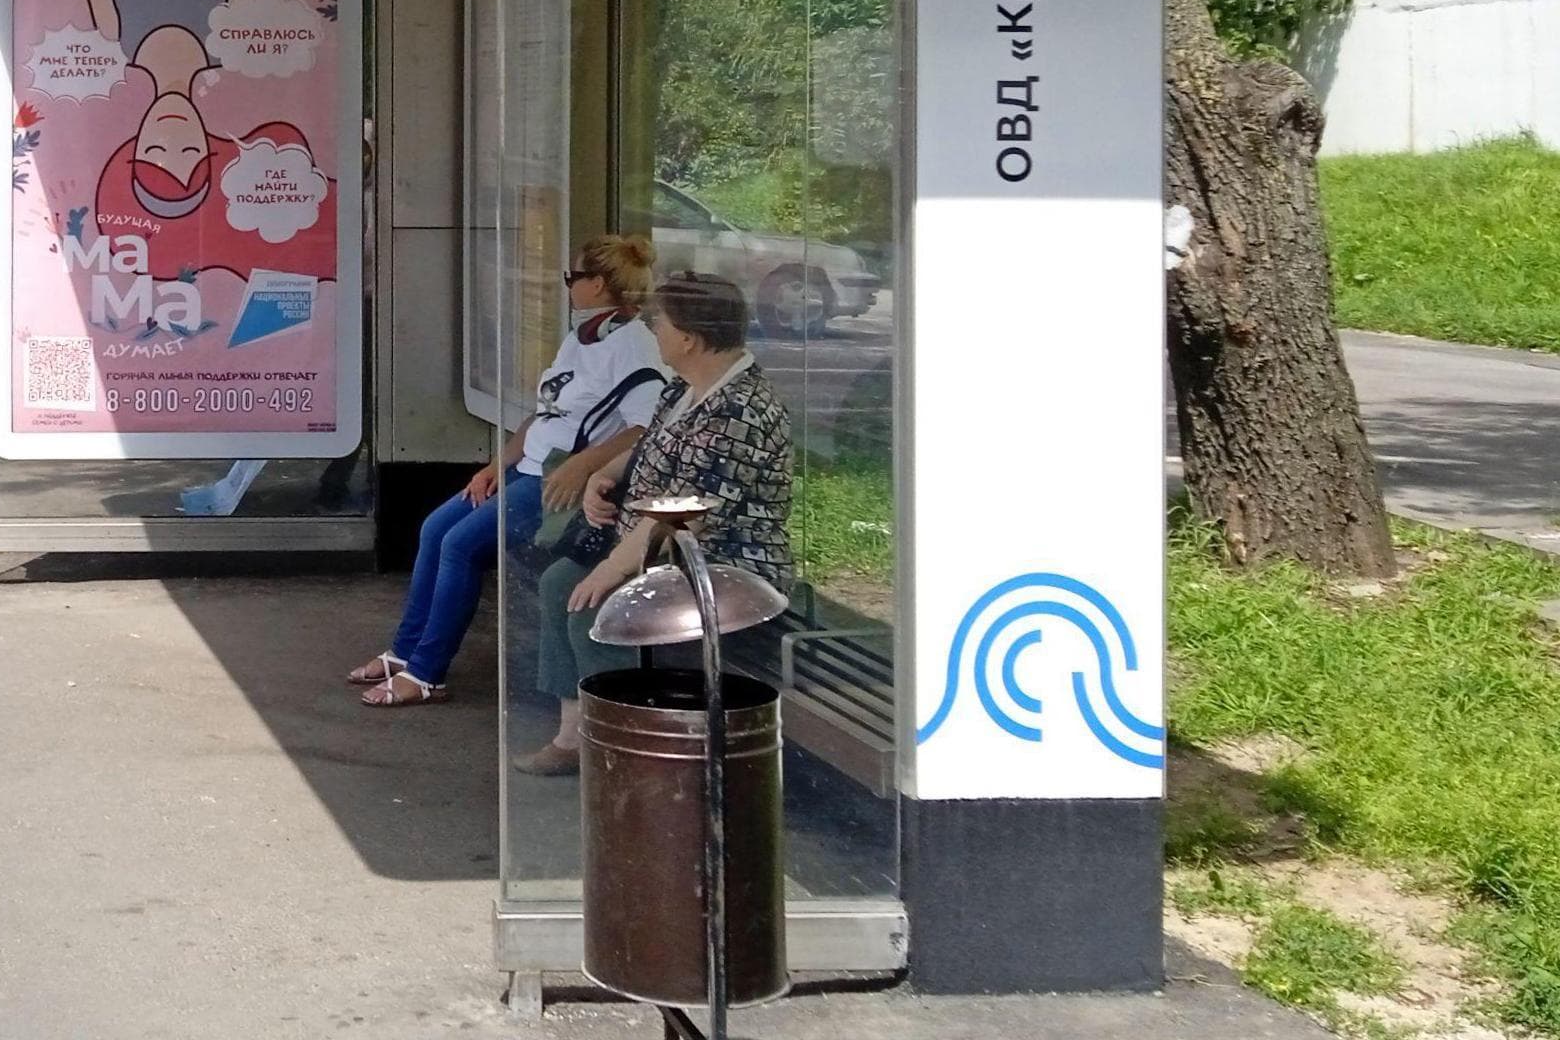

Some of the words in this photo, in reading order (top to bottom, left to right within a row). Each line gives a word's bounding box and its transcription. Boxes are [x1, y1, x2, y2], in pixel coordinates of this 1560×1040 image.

[220, 28, 315, 40] СПРАВЛЮСЬ
[66, 44, 91, 54] ЧТО
[247, 43, 266, 54] ЛИ
[272, 43, 289, 55] Я?
[40, 56, 68, 66] МНЕ
[74, 56, 118, 66] ТЕПЕРЬ
[50, 67, 107, 79] ДЕЛАТЬ?
[996, 76, 1040, 183] ОВД
[265, 169, 288, 180] ГДЕ
[255, 180, 298, 192] НАЙТИ
[236, 194, 316, 205] ПОДДЕРЖКУ?
[97, 213, 162, 234] БУДУЩАЯ
[103, 337, 185, 359] ДУМАЕТ
[106, 372, 155, 381] ГОРЯЧАЯ
[158, 372, 194, 381] ЛИНИЯ
[197, 372, 261, 382] ПОДДЕРЖКИ
[264, 372, 319, 381] ОТВЕЧАЕТ
[105, 388, 314, 412] 8-800-2000-492
